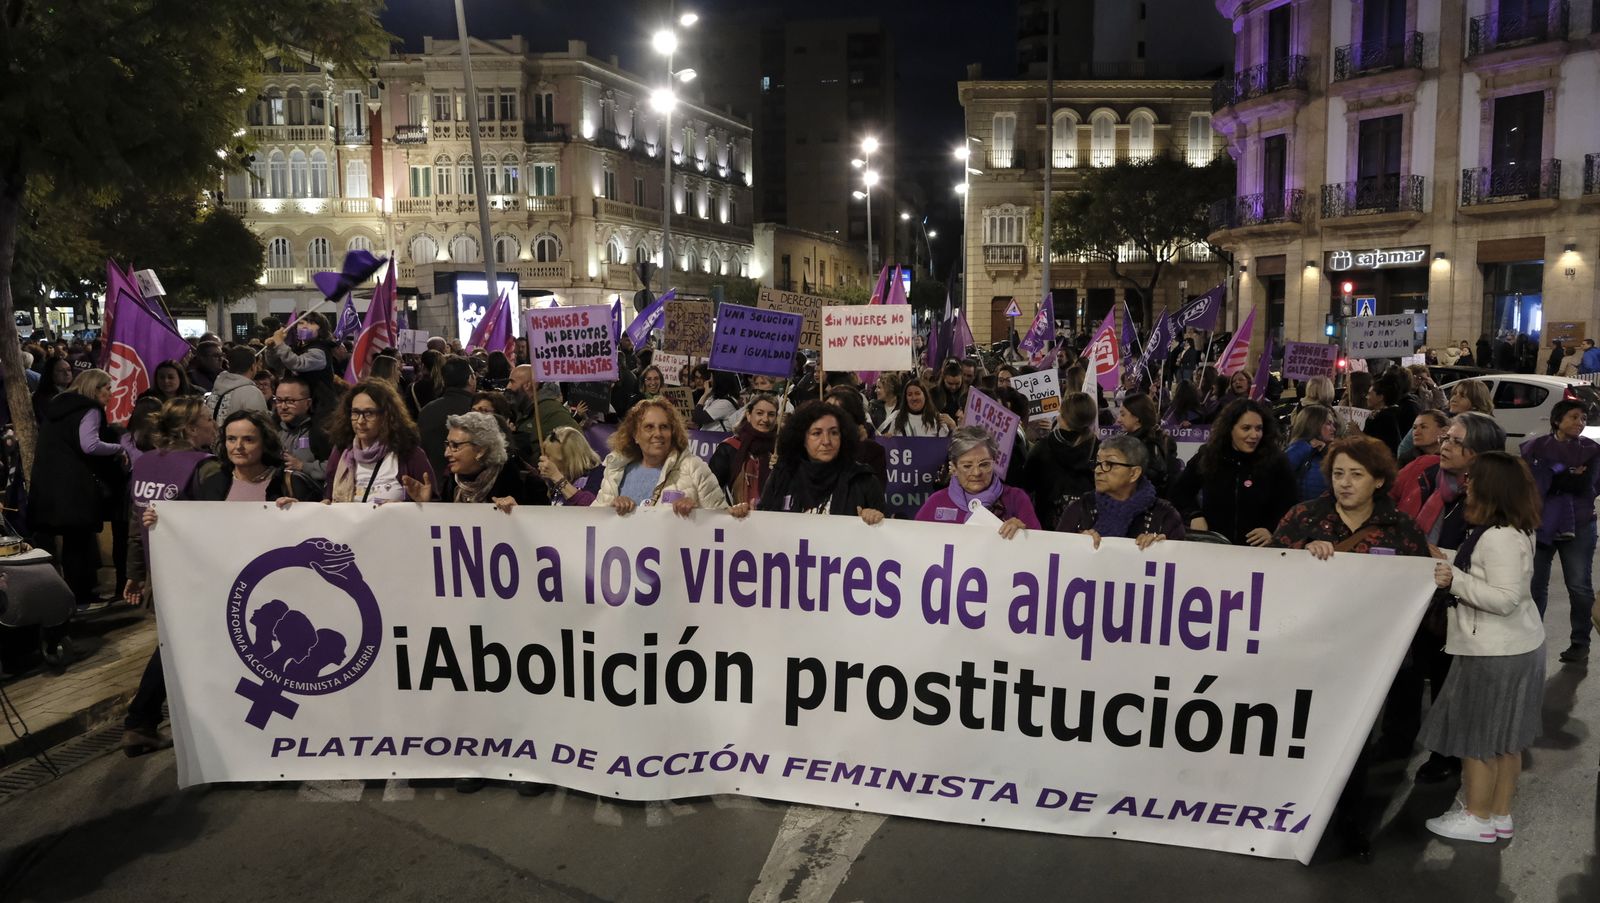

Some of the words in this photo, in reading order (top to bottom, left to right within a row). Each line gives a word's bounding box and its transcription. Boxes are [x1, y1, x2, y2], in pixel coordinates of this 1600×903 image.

[1354, 249, 1425, 269] cajamar
[761, 292, 774, 302] EL
[780, 293, 823, 309] DERECHO
[724, 309, 745, 320] UNA
[845, 312, 888, 326] MUJERES
[892, 314, 904, 324] NO
[560, 325, 608, 341] DEVOTAS
[723, 327, 736, 336] LA
[828, 335, 848, 348] HAY
[1014, 377, 1039, 393] Deja
[1044, 374, 1052, 384] a
[1030, 389, 1056, 400] novio
[886, 469, 933, 487] Muje
[134, 480, 166, 499] UGT
[536, 546, 564, 603] a
[585, 525, 662, 607] los
[680, 528, 902, 619] vientres
[921, 544, 989, 630] de
[1008, 553, 1265, 662] alquiler!
[231, 580, 249, 653] PLATAFORMA
[245, 653, 282, 684] ACCIÓN
[283, 678, 343, 691] FEMINISTA
[785, 657, 1313, 760] prostitución!
[270, 736, 537, 760] PLATAFORMA
[551, 743, 598, 771] DE
[607, 743, 770, 778] ACCIÓN
[782, 757, 1019, 805] FEMINISTA
[1035, 787, 1098, 812] DE
